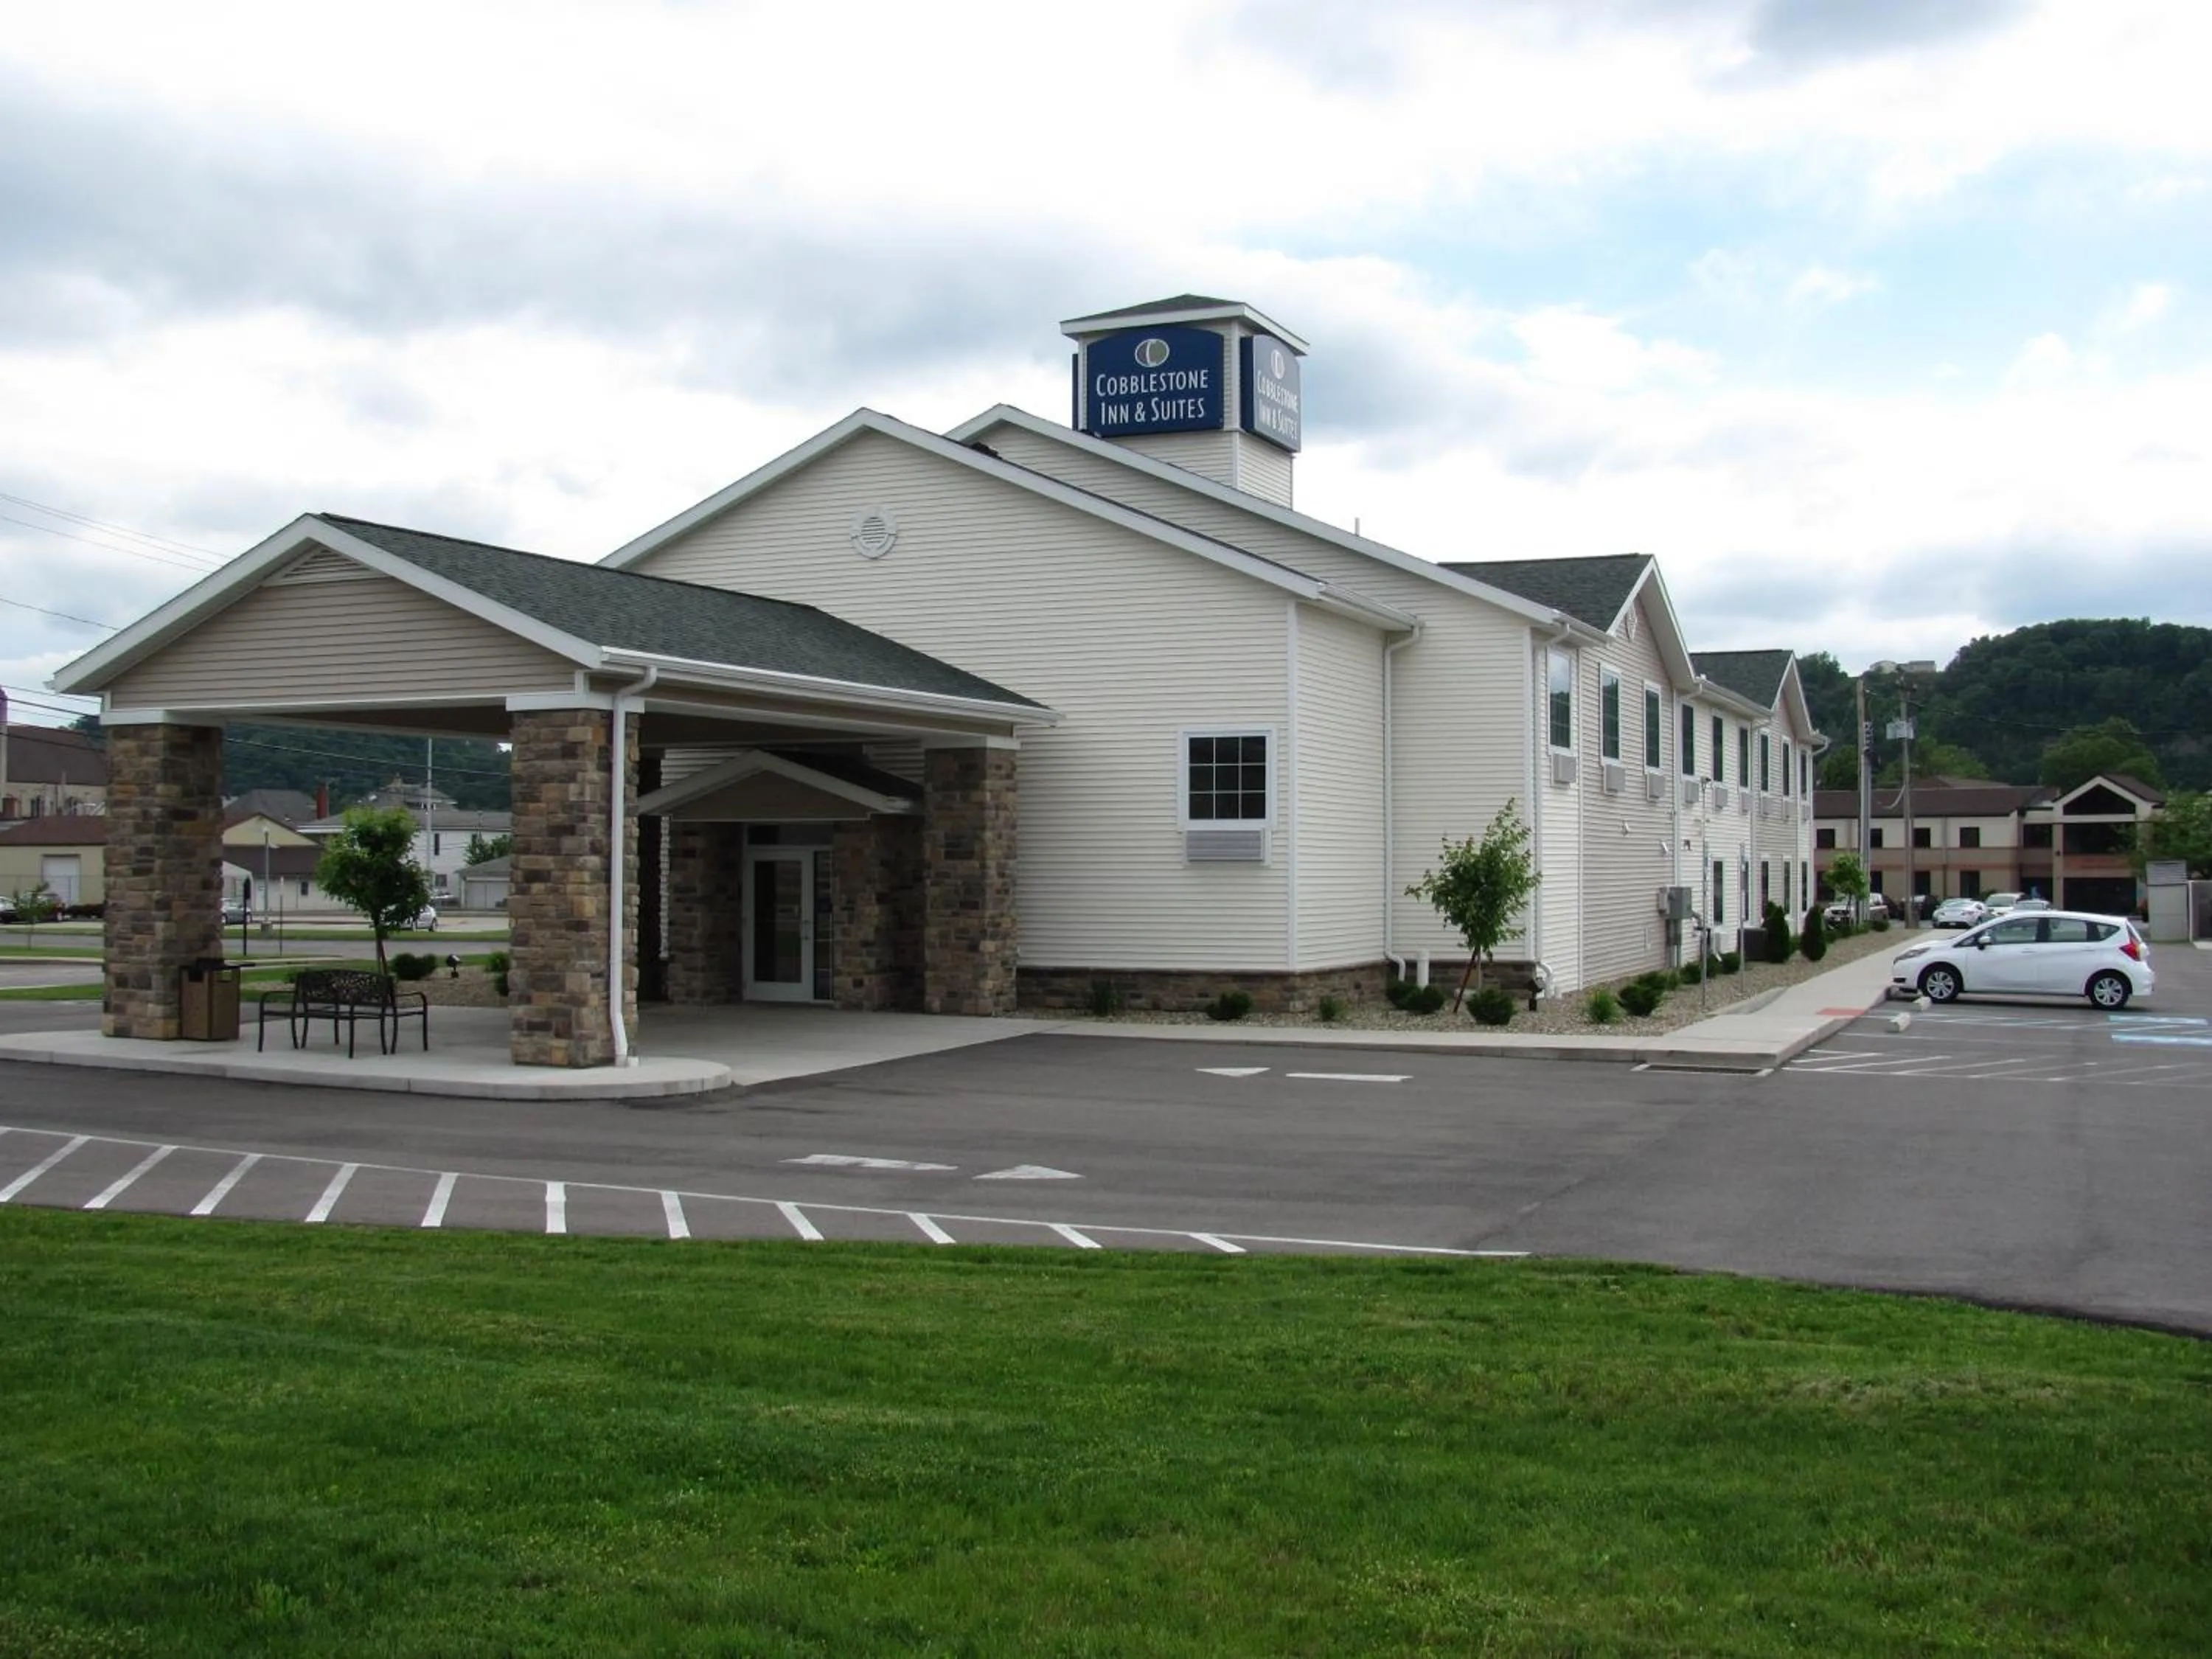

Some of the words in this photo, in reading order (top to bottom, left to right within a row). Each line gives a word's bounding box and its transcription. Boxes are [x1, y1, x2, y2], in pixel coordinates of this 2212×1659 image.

[1096, 369, 1209, 397] COBBLESTONE
[1101, 402, 1130, 425] INN
[1135, 401, 1146, 422] &
[1151, 397, 1206, 422] SUITES
